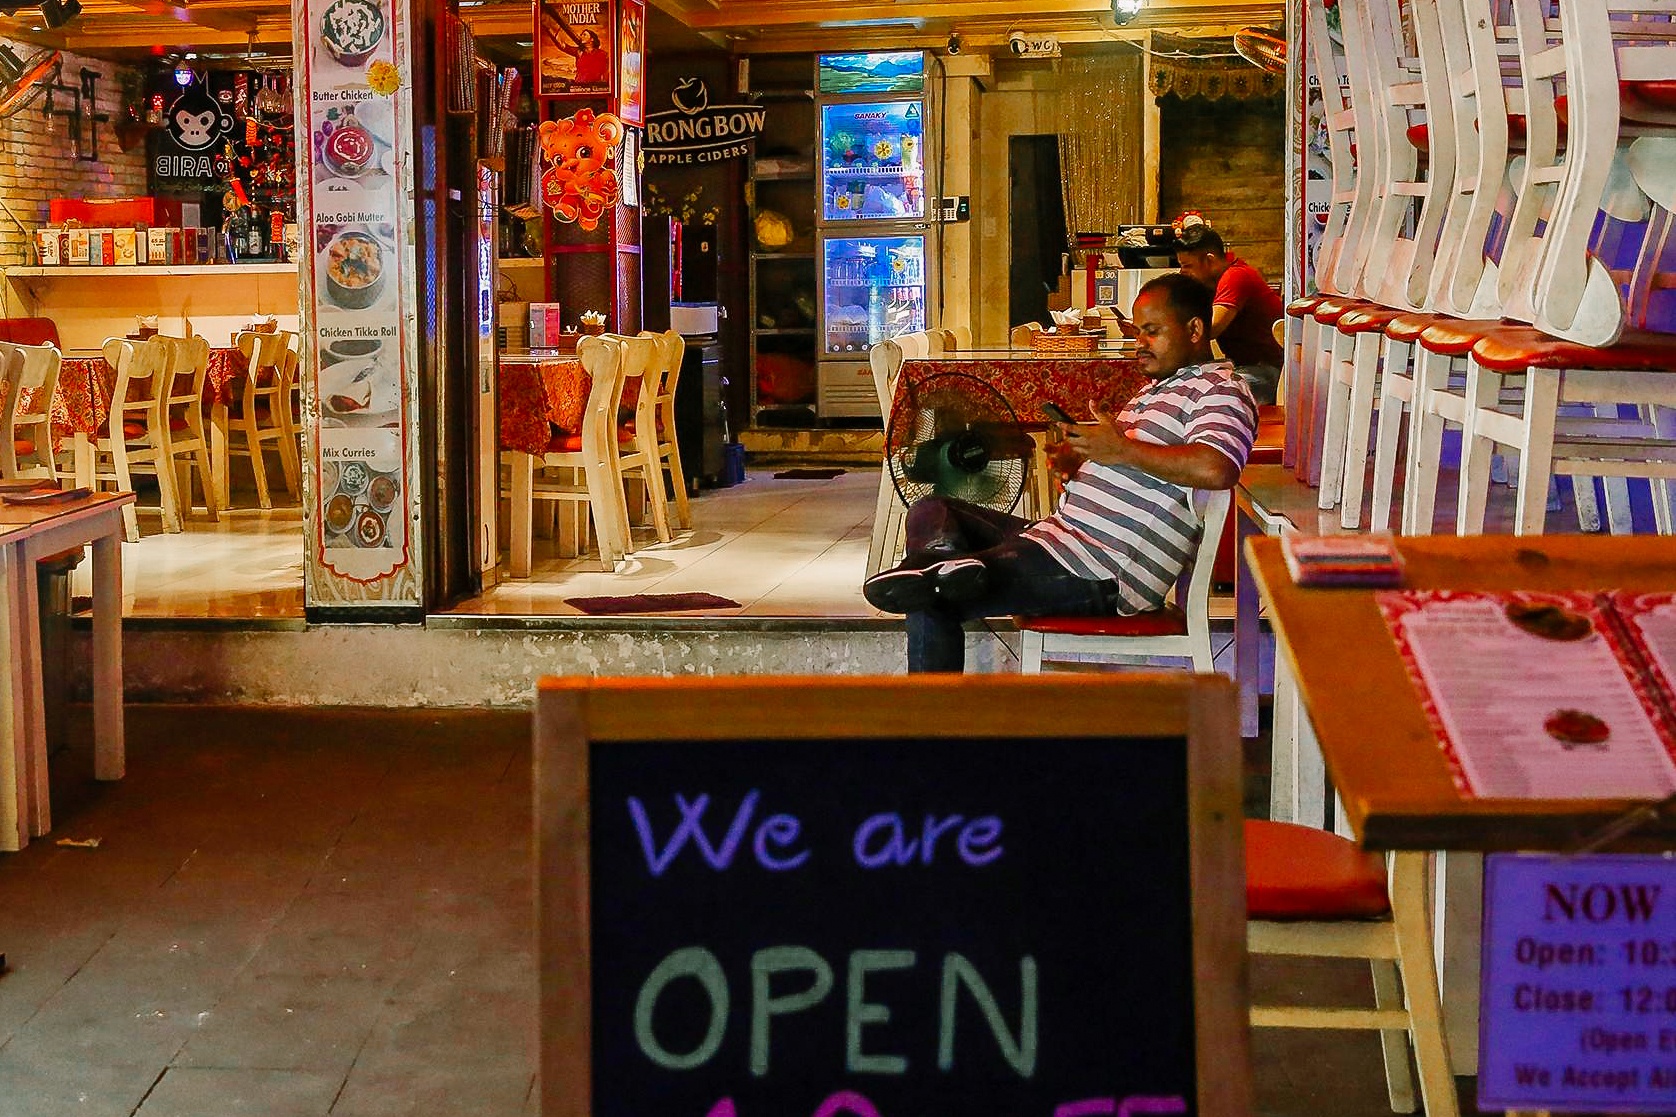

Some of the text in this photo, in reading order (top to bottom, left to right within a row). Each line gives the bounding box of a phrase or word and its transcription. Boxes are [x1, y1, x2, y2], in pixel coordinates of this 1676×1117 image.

[563, 3, 600, 14] MOTHER
[569, 14, 597, 24] INDIA
[313, 90, 373, 100] Butter Chicken
[854, 112, 887, 120] SANAKY
[647, 111, 767, 143] RONGBOW
[648, 144, 748, 164] APPLE CIDERS
[156, 155, 228, 177] BIRA 91
[316, 212, 384, 222] Aloo Gobi Mutter
[320, 328, 352, 338] Chicken
[381, 327, 397, 336] Roll
[323, 448, 375, 458] Mix Curries
[627, 787, 1005, 876] We are
[1544, 882, 1661, 922] NOW
[1515, 936, 1676, 969] Open: 10:
[633, 944, 1037, 1077] OPEN
[1581, 1027, 1647, 1055] (Open
[1514, 1064, 1551, 1086] We
[1562, 1065, 1638, 1092] Accept
